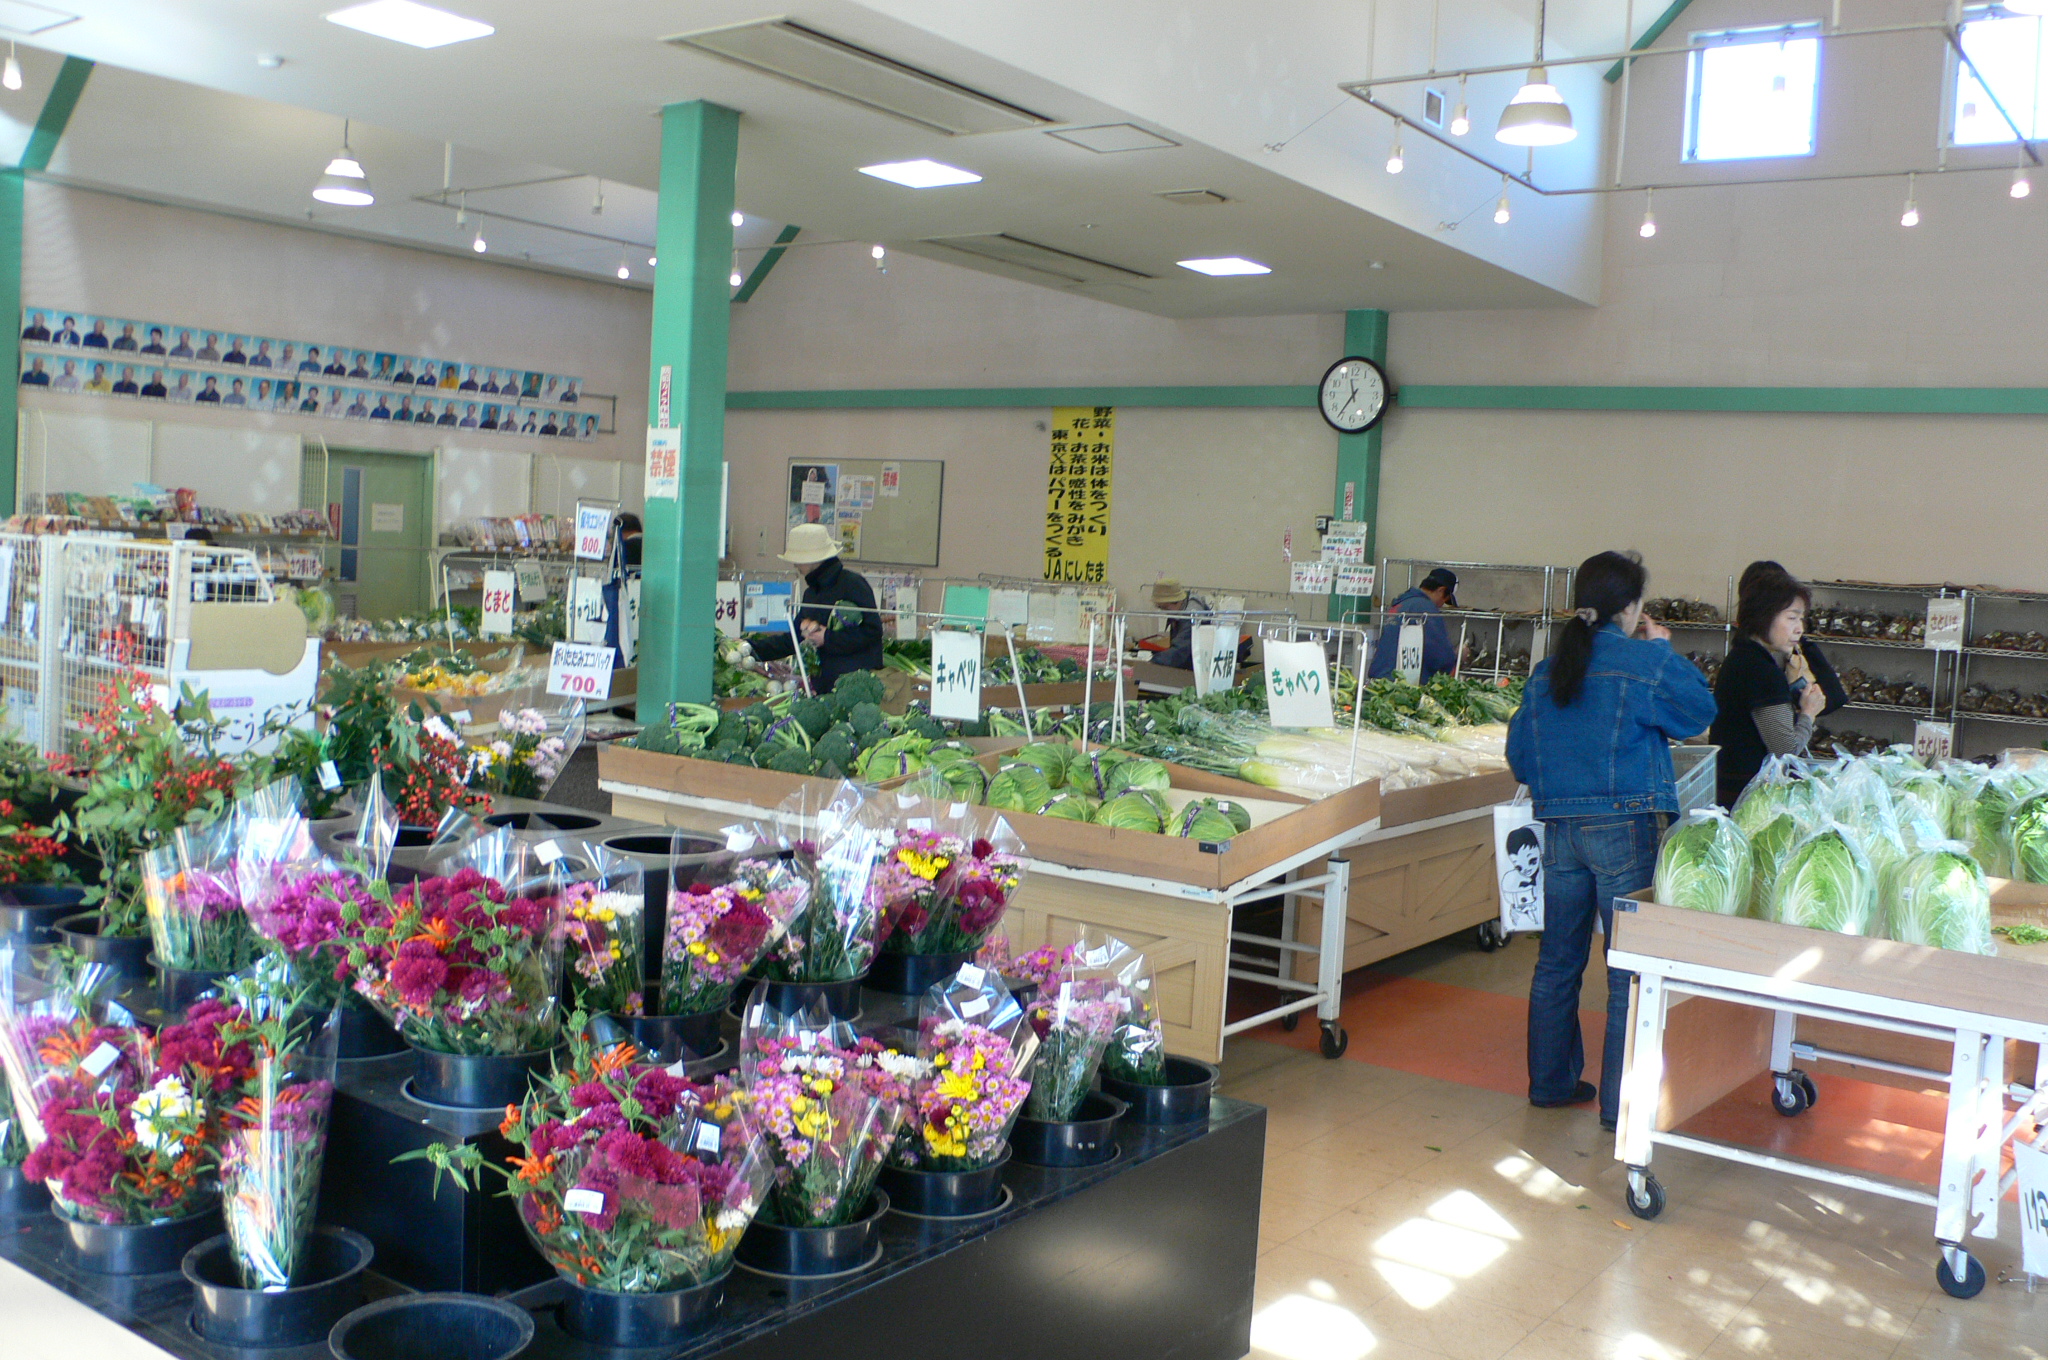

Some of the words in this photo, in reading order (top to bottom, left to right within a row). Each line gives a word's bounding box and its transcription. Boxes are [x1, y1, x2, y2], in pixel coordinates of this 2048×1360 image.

[1351, 367, 1360, 376] 12
[1333, 380, 1341, 388] 10
[1370, 378, 1376, 387] 2
[1329, 391, 1336, 399] 9
[1372, 391, 1379, 400] 3
[1332, 403, 1338, 412] 8
[1348, 415, 1355, 424] 6
[650, 449, 677, 477] 禁煙
[1335, 546, 1363, 557] キムチ
[1044, 558, 1105, 582] JAにしたま
[484, 588, 512, 613] とまと
[1930, 613, 1959, 632] さといも
[1212, 649, 1235, 678] 大根
[936, 654, 977, 694] キャベツ
[1272, 667, 1321, 697] きゃべつ
[1918, 735, 1949, 757] さといも
